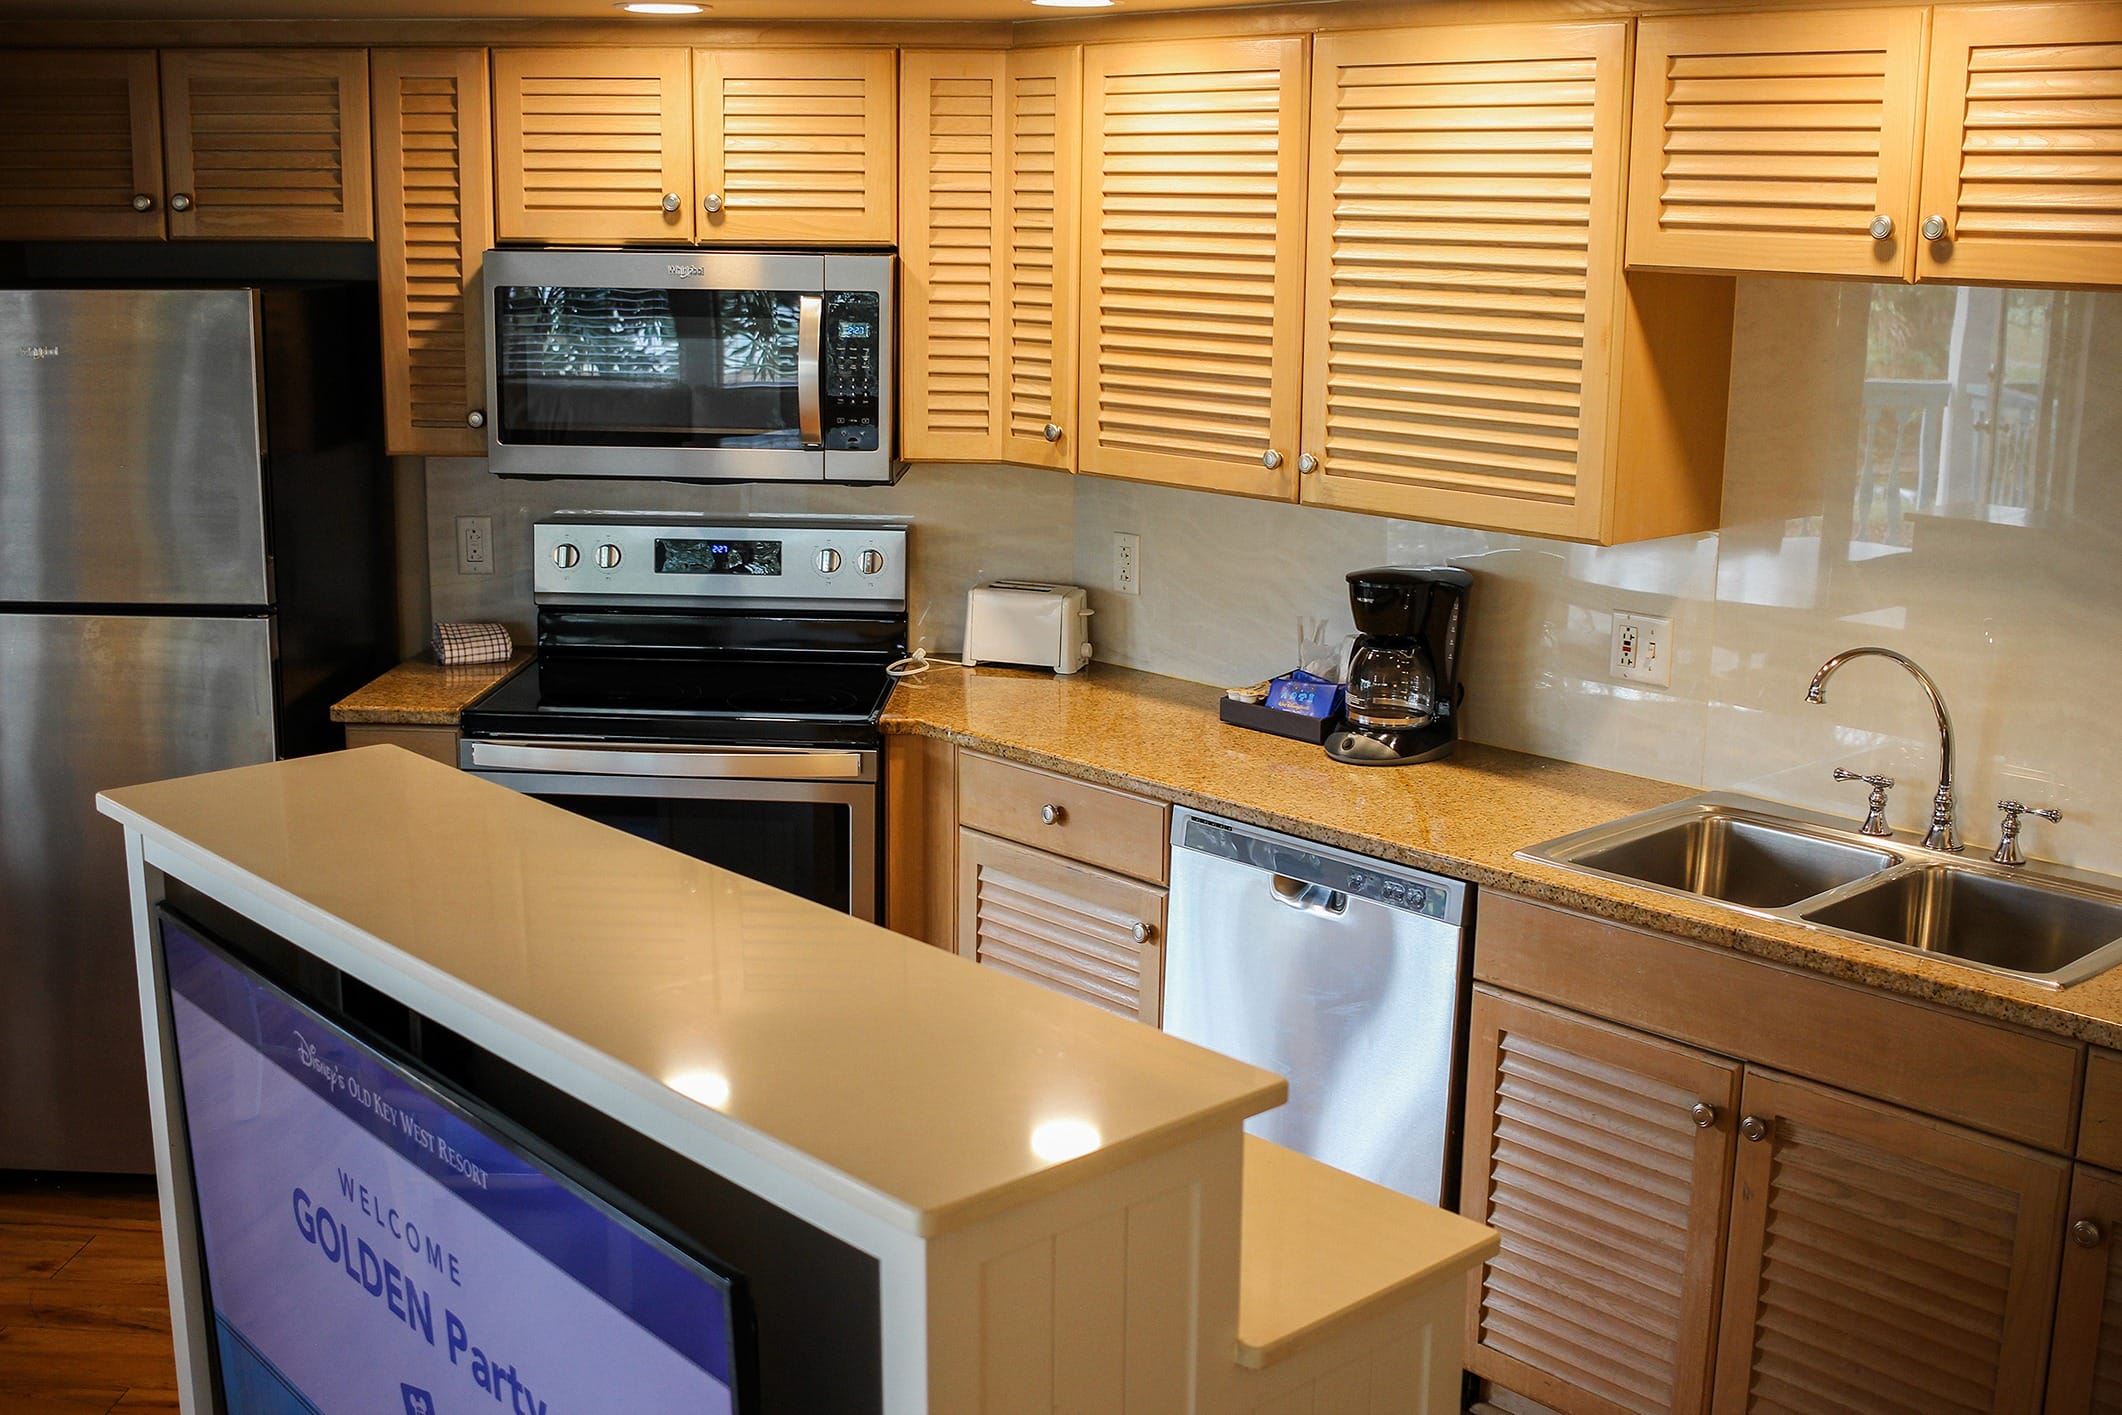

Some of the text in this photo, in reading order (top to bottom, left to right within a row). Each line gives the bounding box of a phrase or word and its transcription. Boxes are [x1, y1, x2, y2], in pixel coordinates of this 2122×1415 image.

[348, 1077, 371, 1108] OLD
[373, 1093, 398, 1126] KEY
[400, 1111, 435, 1153] WEST
[438, 1136, 488, 1189] RESORT
[293, 1187, 435, 1347] GOLDEN
[337, 1168, 461, 1287] WELCOME
